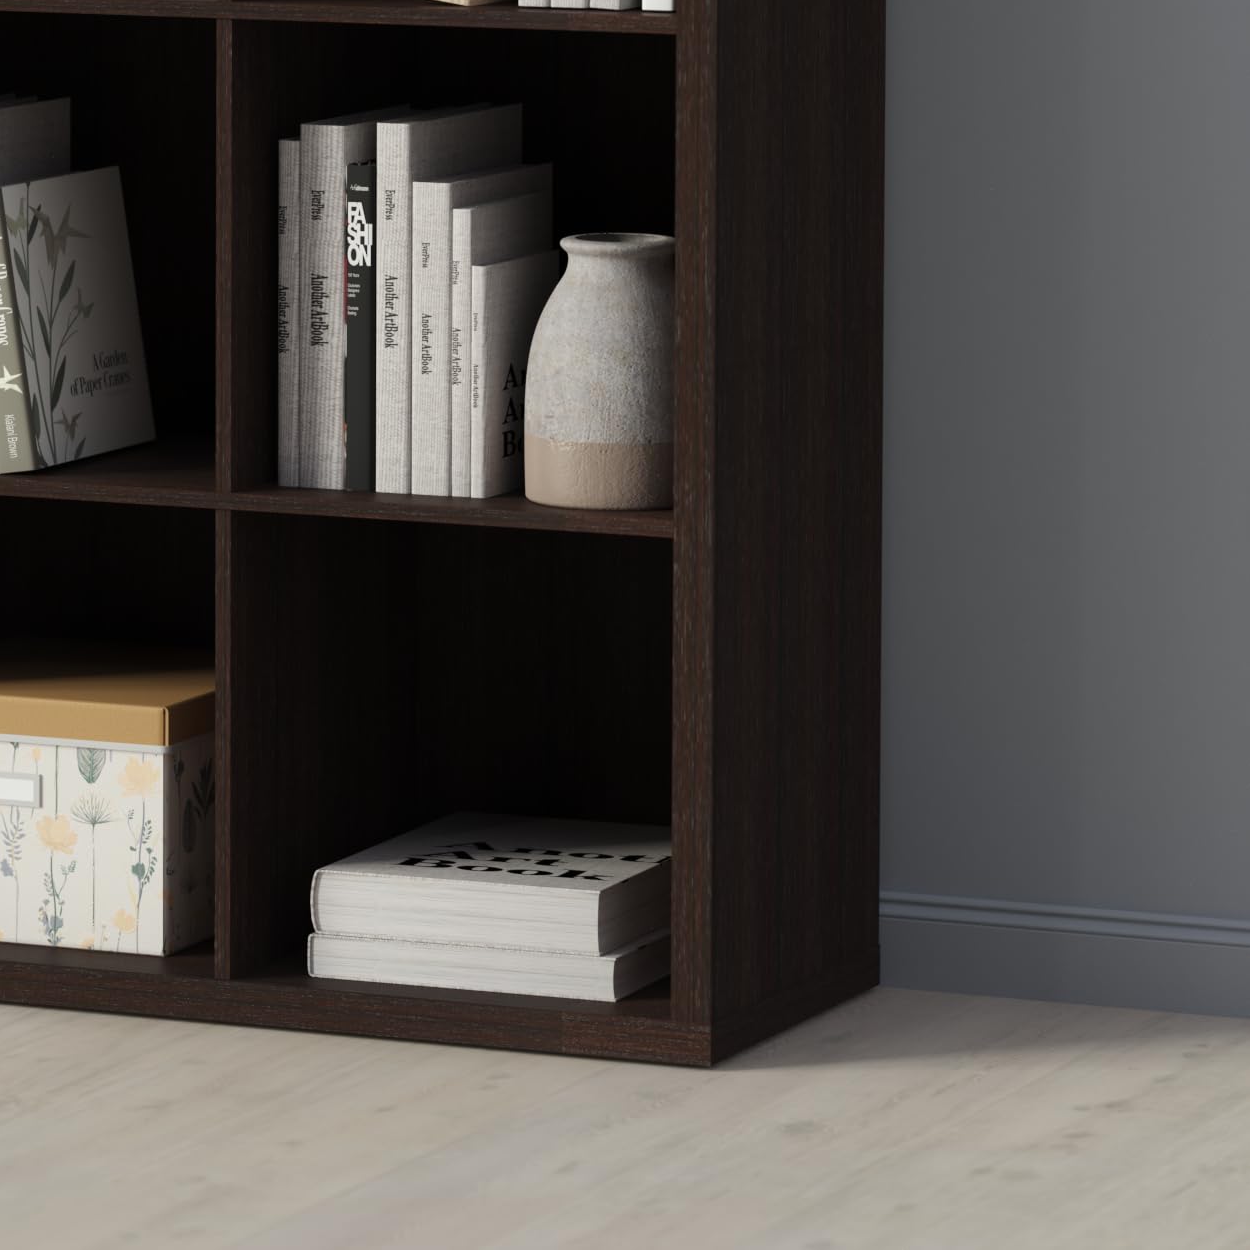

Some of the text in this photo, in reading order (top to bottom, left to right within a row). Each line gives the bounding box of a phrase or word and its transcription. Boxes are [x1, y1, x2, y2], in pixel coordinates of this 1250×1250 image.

[311, 189, 325, 221] EverPress
[385, 189, 396, 221] EverPress
[421, 242, 430, 268] EverPress
[278, 284, 290, 353] Another ArtBook
[311, 272, 330, 347] Another ArtBook
[384, 274, 399, 349] Another ArtBook
[421, 312, 433, 375] Another ArtBook
[452, 327, 462, 386] Another ArtBook
[93, 349, 127, 371] A Garden
[70, 370, 131, 397] of Paper Cranes
[7, 436, 18, 458] Brown
[400, 857, 616, 881] Book
